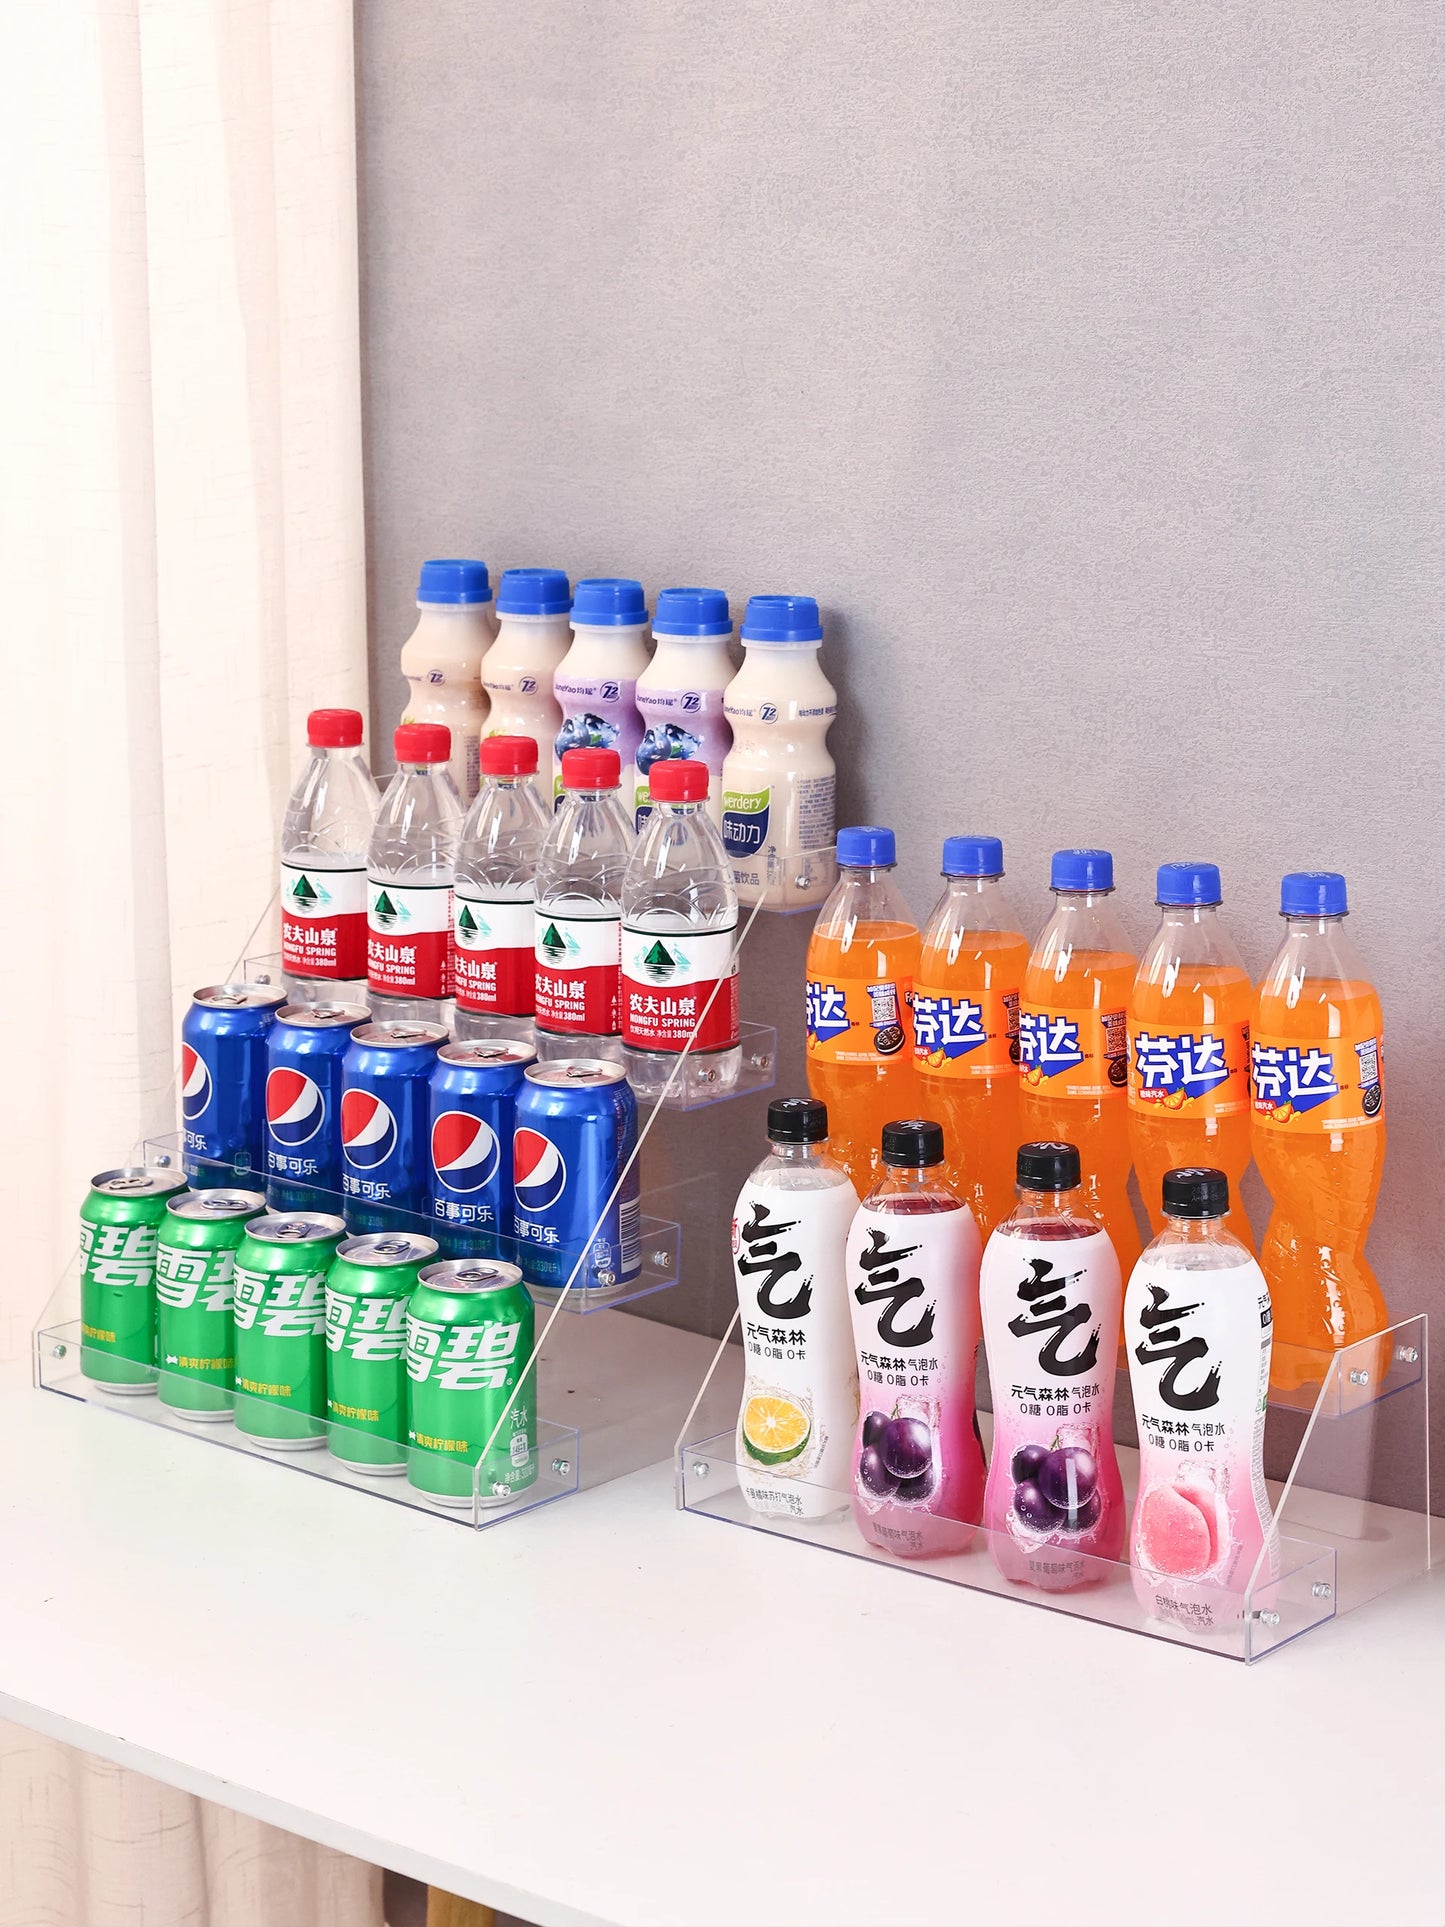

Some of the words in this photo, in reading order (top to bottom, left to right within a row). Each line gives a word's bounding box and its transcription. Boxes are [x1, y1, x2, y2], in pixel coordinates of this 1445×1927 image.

[724, 819, 761, 845] 味动力
[283, 921, 336, 947] 农夫山泉
[305, 947, 337, 958] SPRING
[385, 963, 416, 976] SPRING
[468, 978, 497, 992] SPRING
[554, 998, 586, 1012] SPRING
[563, 1011, 586, 1022] 380ml
[629, 993, 696, 1017] 农夫山泉
[629, 1012, 659, 1027] NONGFU
[661, 1017, 697, 1029] SPRING
[914, 990, 987, 1046] 芬达
[1135, 1032, 1229, 1088] 芬达
[1252, 1042, 1338, 1099] 芬达
[268, 1150, 319, 1177] 百事可乐
[342, 1172, 391, 1199] 百事可乐
[434, 1198, 495, 1223] 百事可乐
[747, 1321, 807, 1346] 元气森林
[406, 1311, 521, 1391] 雪碧
[861, 1350, 906, 1372] 元气森林
[907, 1357, 939, 1371] 气泡水
[1011, 1384, 1070, 1402] 元气森林
[1071, 1382, 1101, 1400] 气泡水
[1142, 1413, 1190, 1437] 元气森林
[1190, 1422, 1226, 1437] 气泡水
